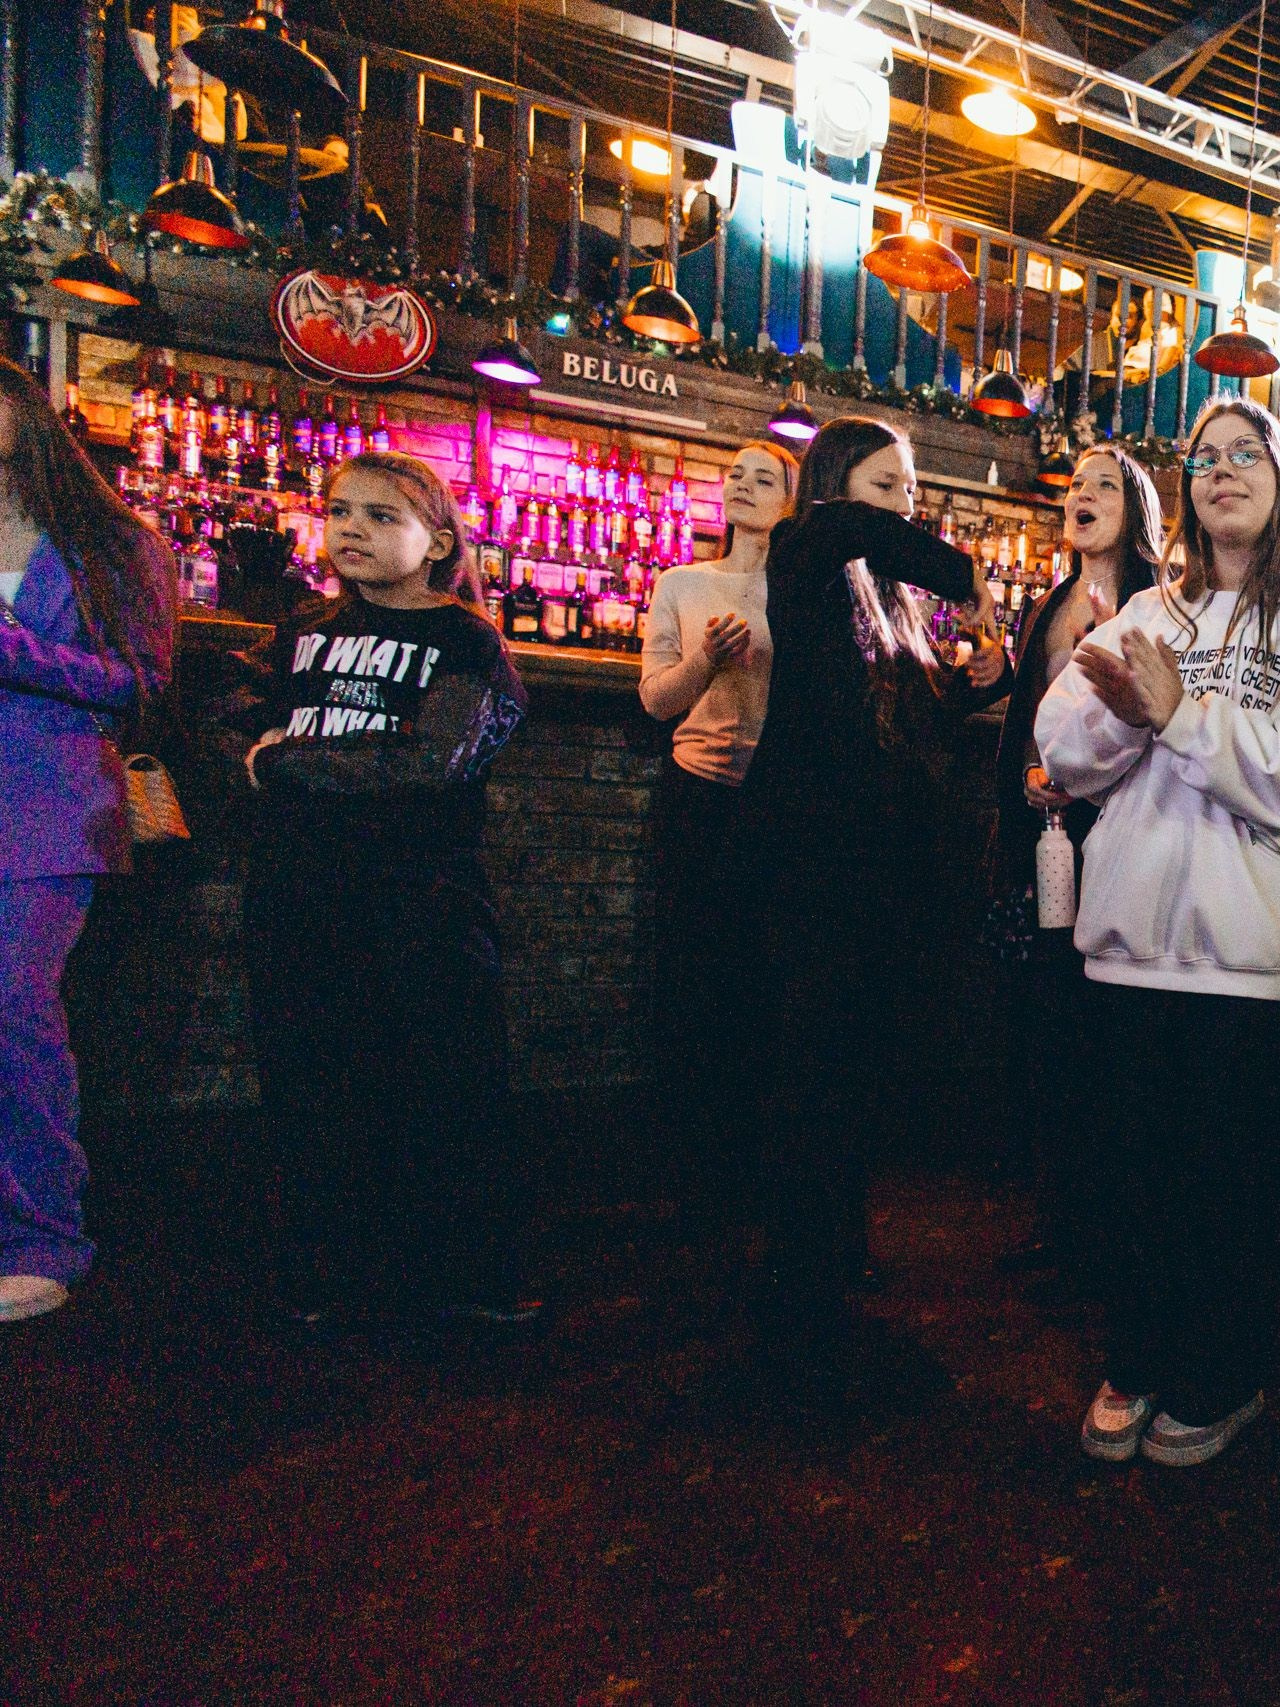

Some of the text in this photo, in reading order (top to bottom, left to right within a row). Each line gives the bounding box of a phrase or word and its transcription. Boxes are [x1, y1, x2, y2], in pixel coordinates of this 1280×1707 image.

[563, 352, 678, 397] BELUGA
[292, 633, 327, 673] DO
[322, 635, 418, 683] WHAT
[321, 707, 399, 737] WHAT
